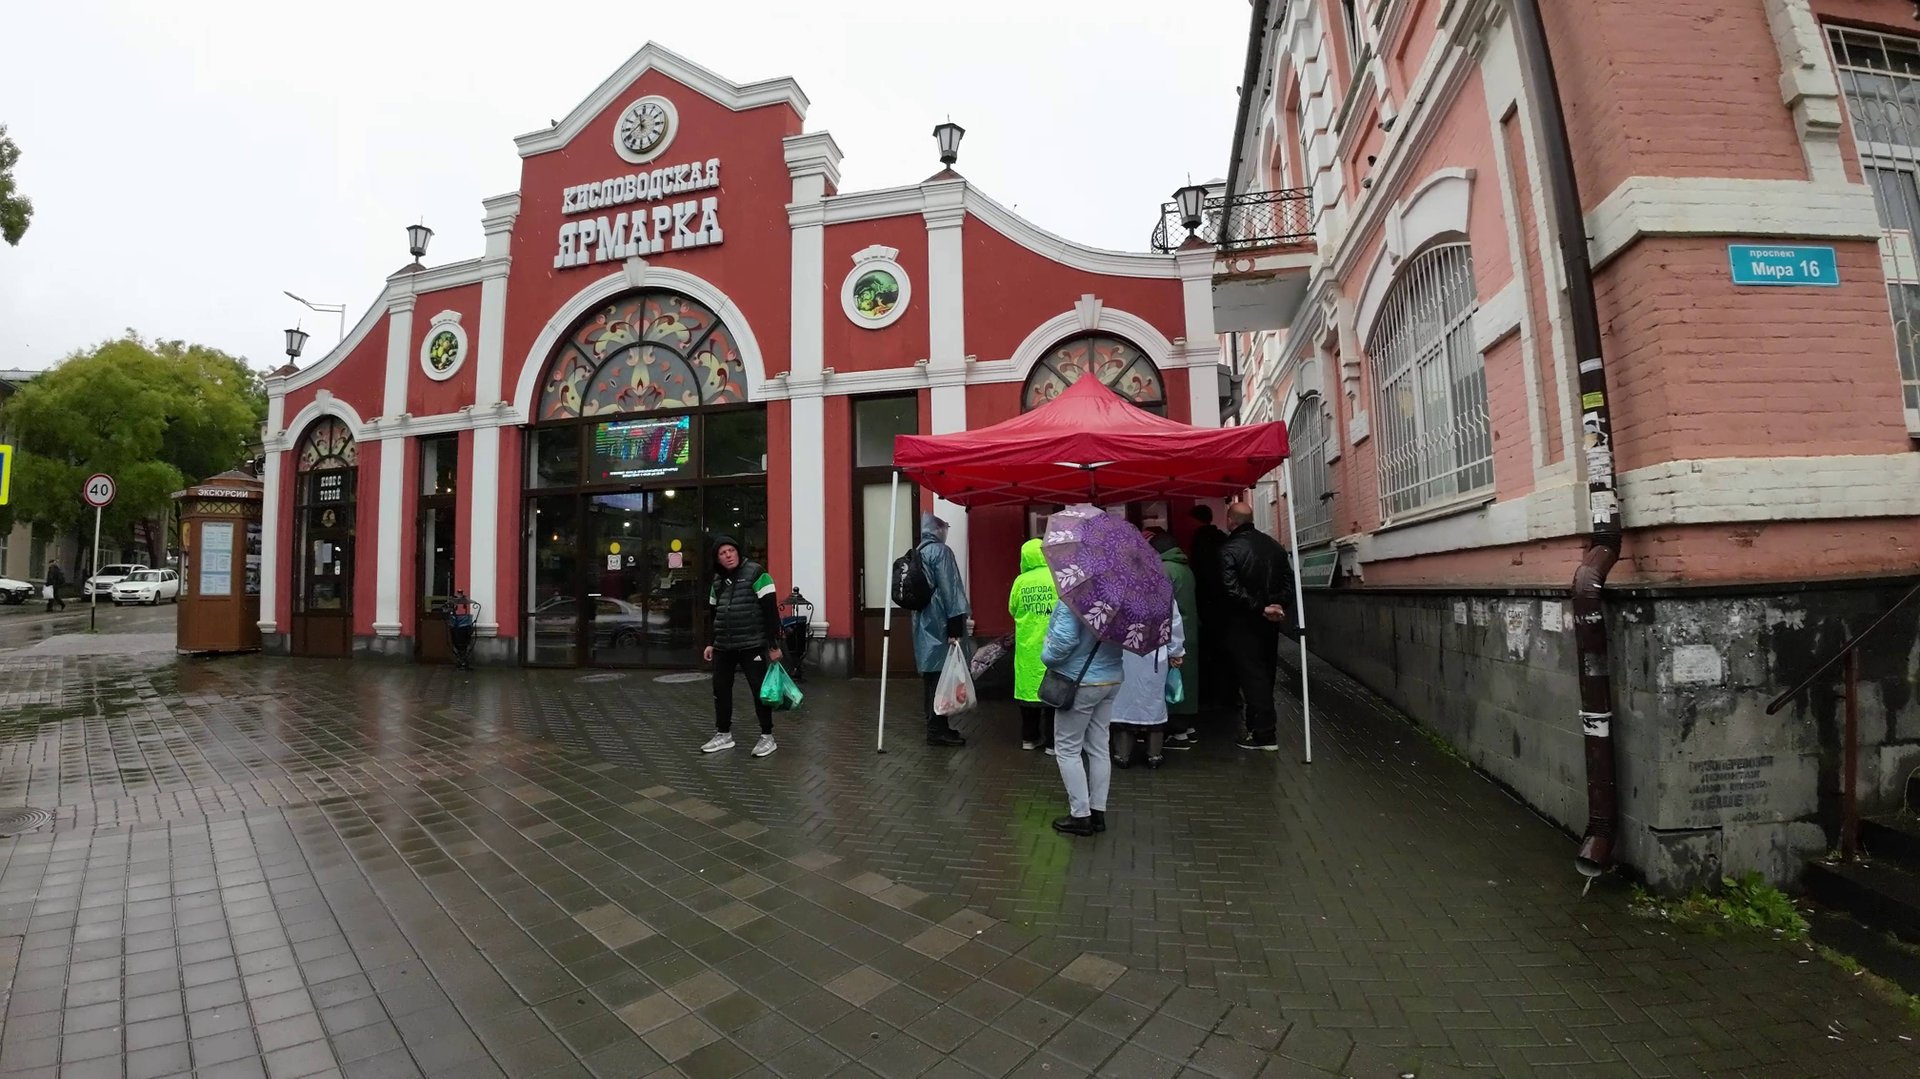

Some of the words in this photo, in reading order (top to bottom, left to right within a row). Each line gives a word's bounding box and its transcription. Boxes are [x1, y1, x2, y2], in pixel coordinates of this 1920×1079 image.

[561, 158, 721, 215] КИСЛОВОДСКАЯ
[553, 196, 724, 269] ЯРМАРКА
[1749, 249, 1795, 258] проспект
[1751, 261, 1794, 279] Мира
[1799, 260, 1821, 277] 16
[89, 484, 108, 496] 40
[197, 489, 249, 498] ЭКСКУРСИИ
[319, 487, 341, 501] ТОБОЙ
[1021, 585, 1052, 595] ПОЛГОДА
[1022, 593, 1052, 603] ПЛОХАЯ
